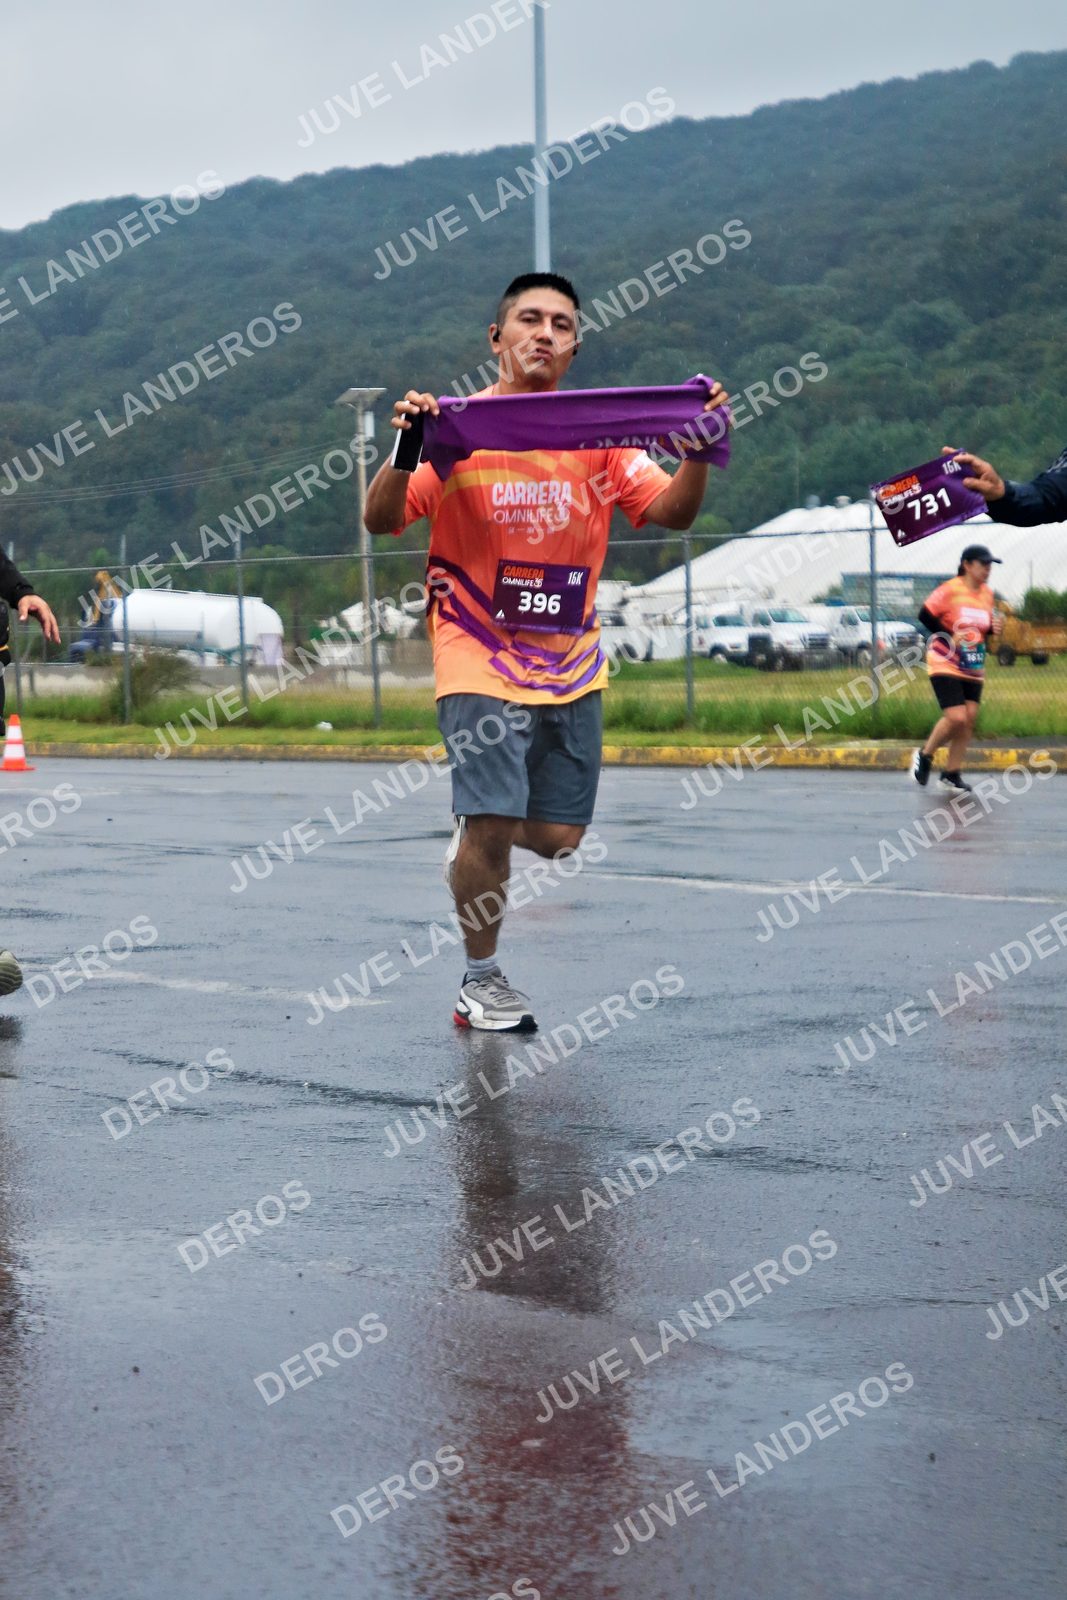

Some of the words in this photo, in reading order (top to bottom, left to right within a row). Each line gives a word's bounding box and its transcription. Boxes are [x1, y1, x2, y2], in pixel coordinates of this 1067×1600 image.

[492, 480, 572, 506] CARRERA
[906, 487, 952, 521] 731
[503, 565, 545, 579] CARRERA
[517, 590, 562, 615] 396
